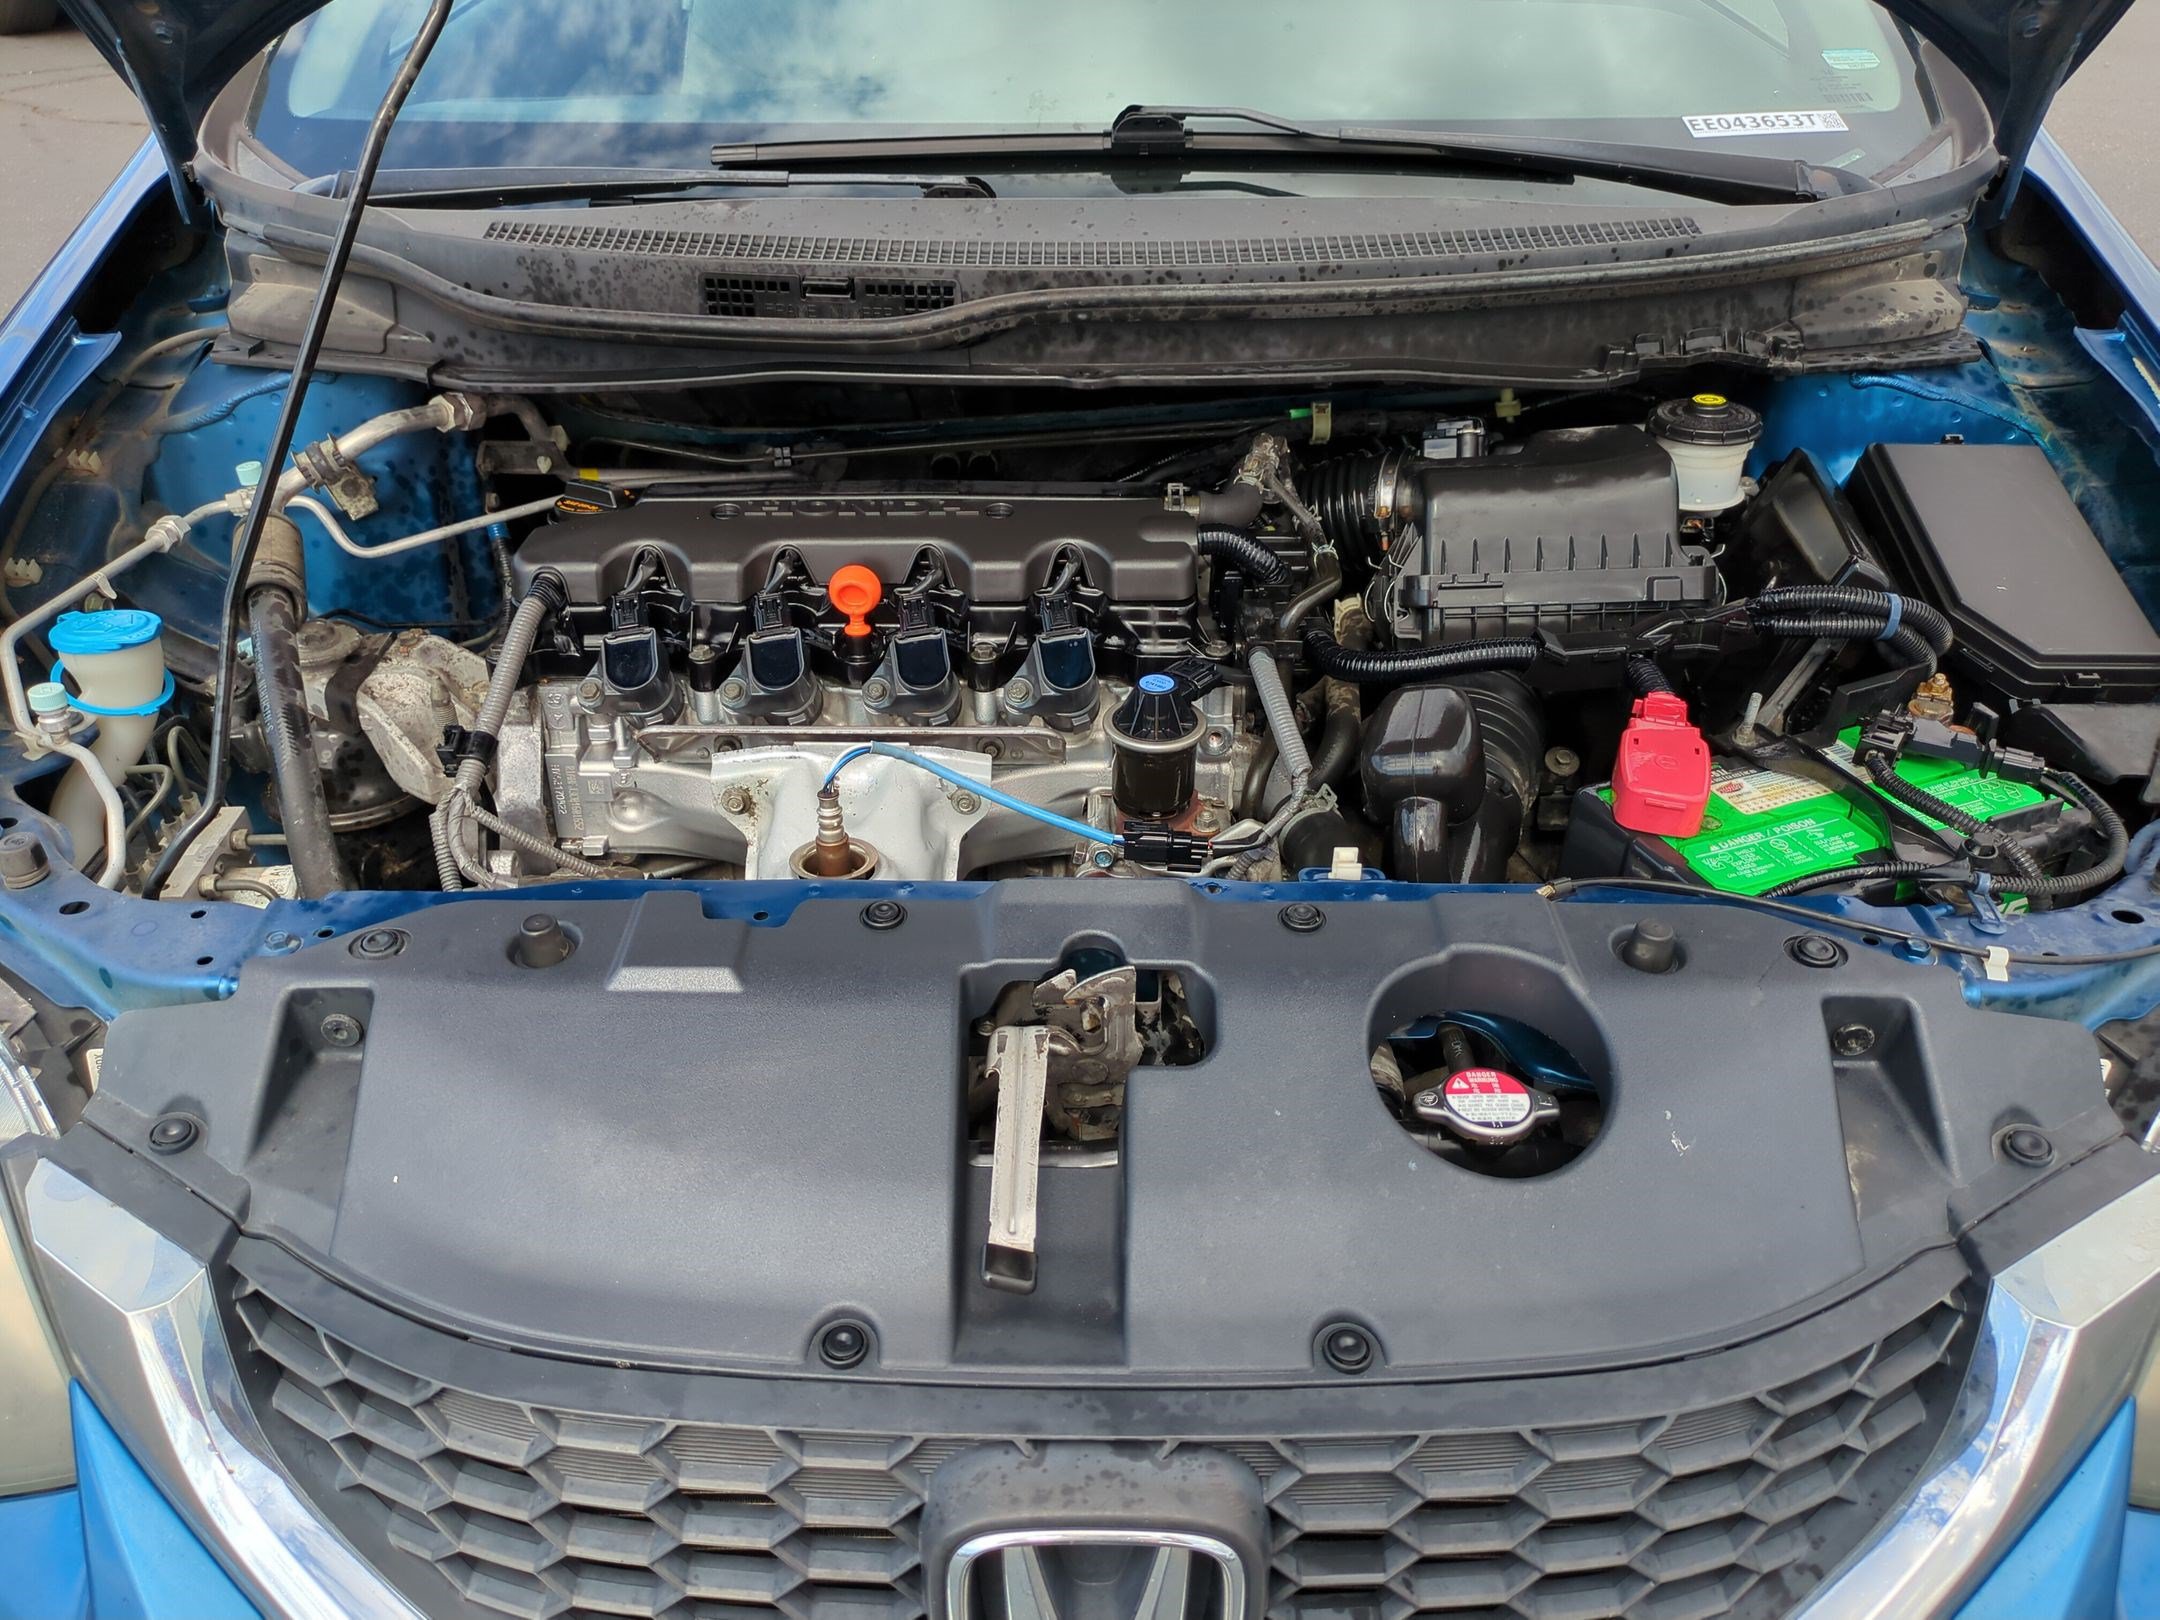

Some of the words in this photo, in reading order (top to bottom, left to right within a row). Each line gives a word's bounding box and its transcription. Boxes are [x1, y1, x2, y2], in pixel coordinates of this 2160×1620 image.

[1687, 113, 1817, 131] EE043653T
[743, 500, 980, 516] HONDA
[1718, 832, 1765, 849] DANGER
[1773, 818, 1816, 834] POISON
